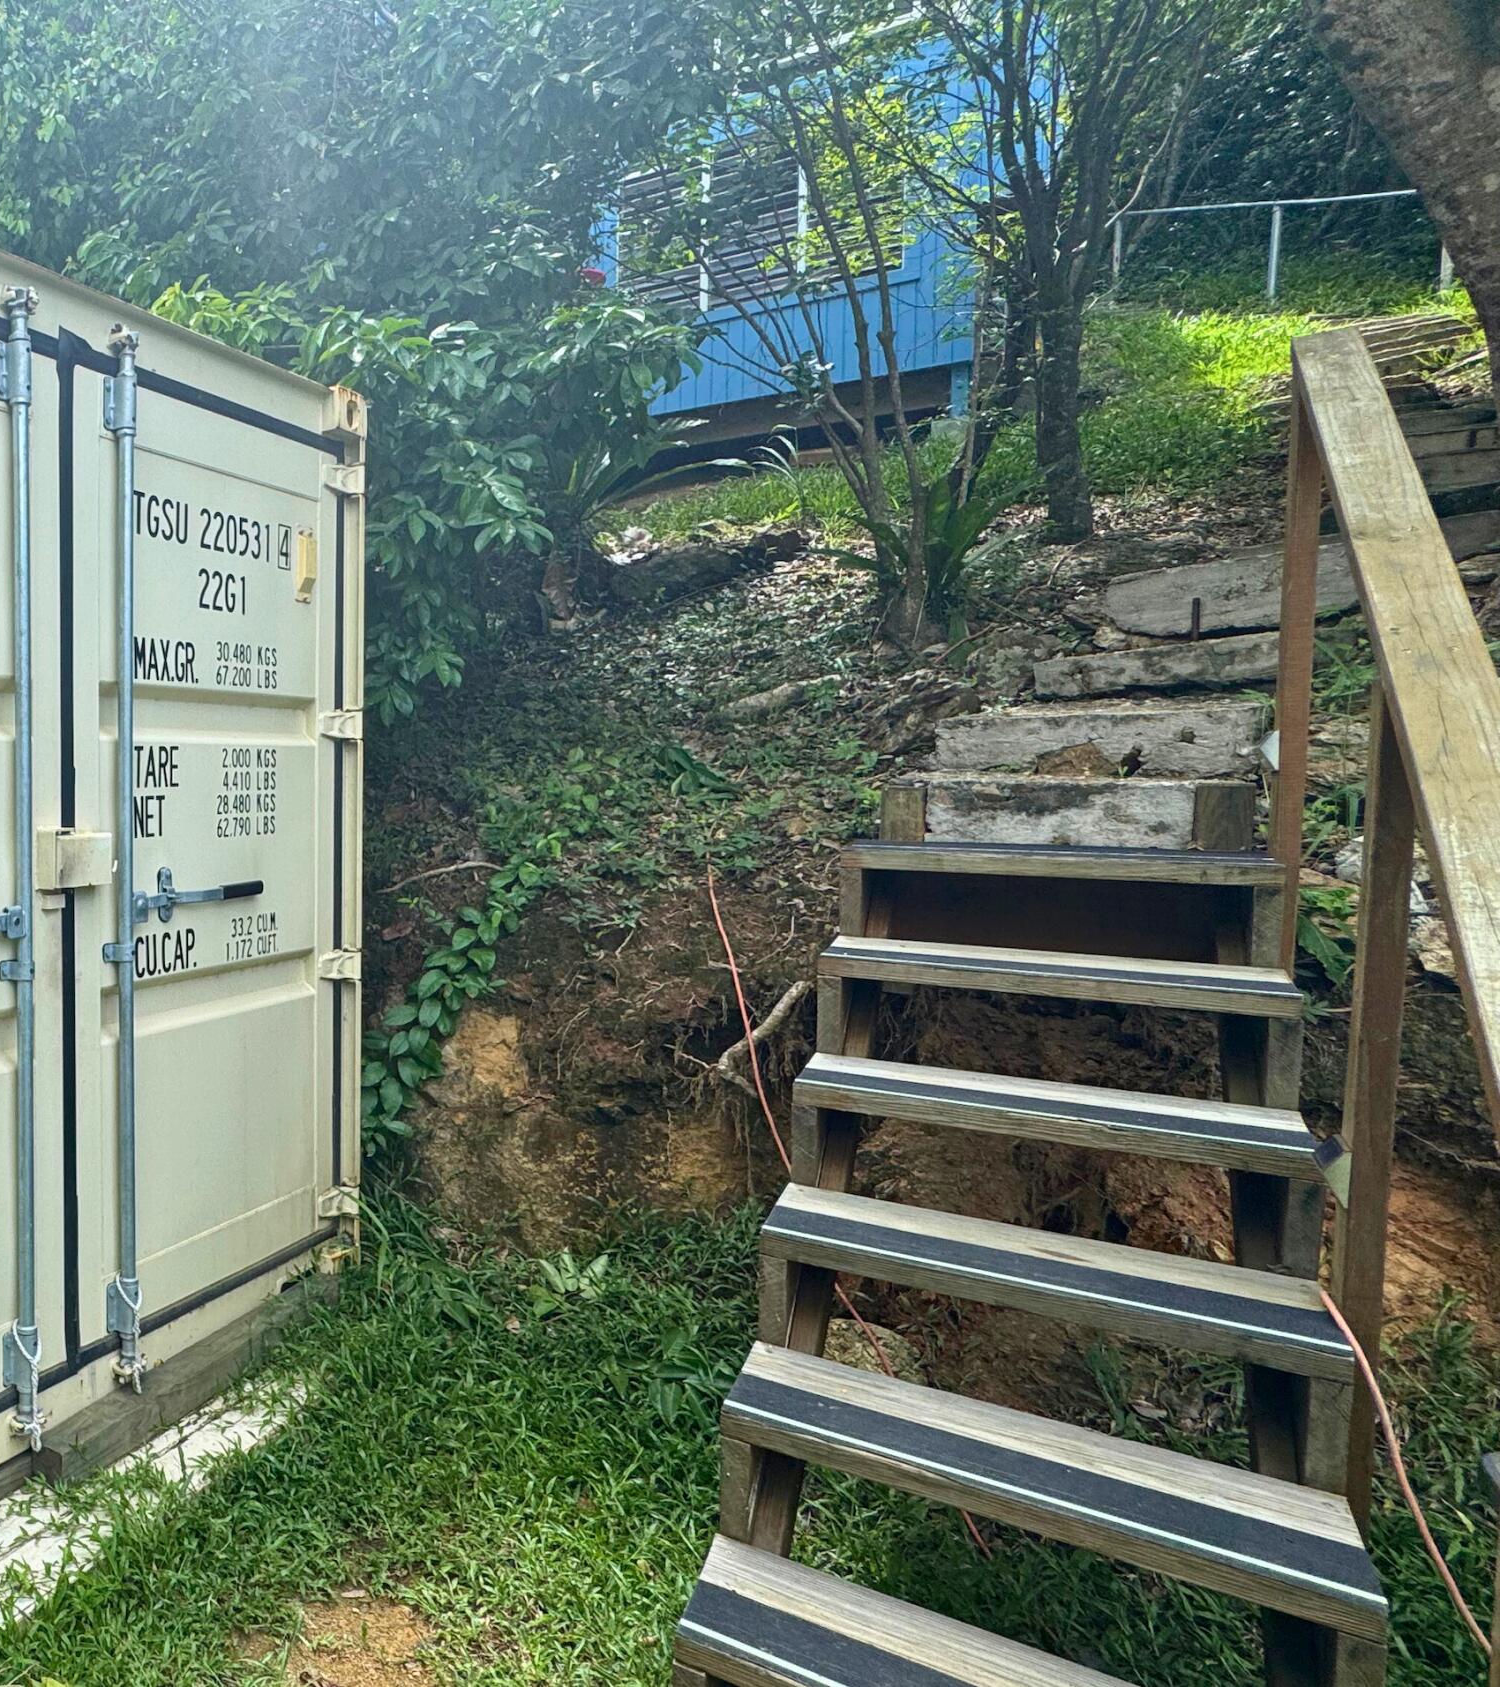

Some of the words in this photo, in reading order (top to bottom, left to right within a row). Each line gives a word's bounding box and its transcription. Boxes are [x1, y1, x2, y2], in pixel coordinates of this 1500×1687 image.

[133, 490, 189, 545] TGSU
[200, 508, 270, 563] 220531
[279, 526, 291, 568] 4
[199, 568, 246, 615] 22G1
[134, 636, 199, 684] MAX.GR.
[216, 641, 251, 664] 30.480
[257, 644, 278, 667] KGS
[216, 665, 251, 687] 67.200
[257, 668, 278, 689] LBS
[134, 745, 179, 788] TARE
[222, 748, 251, 769] 2.000
[257, 748, 277, 769] KGS
[222, 771, 251, 792] 4.410
[257, 770, 276, 791] LBS
[134, 795, 165, 838] NET
[216, 794, 251, 815] 28.480
[256, 793, 276, 813] KGS
[216, 816, 251, 838] 62.790
[256, 816, 276, 835] LBS
[231, 915, 253, 938] 33.2
[134, 928, 197, 979] CU.CAP.
[226, 938, 253, 961] 1.172
